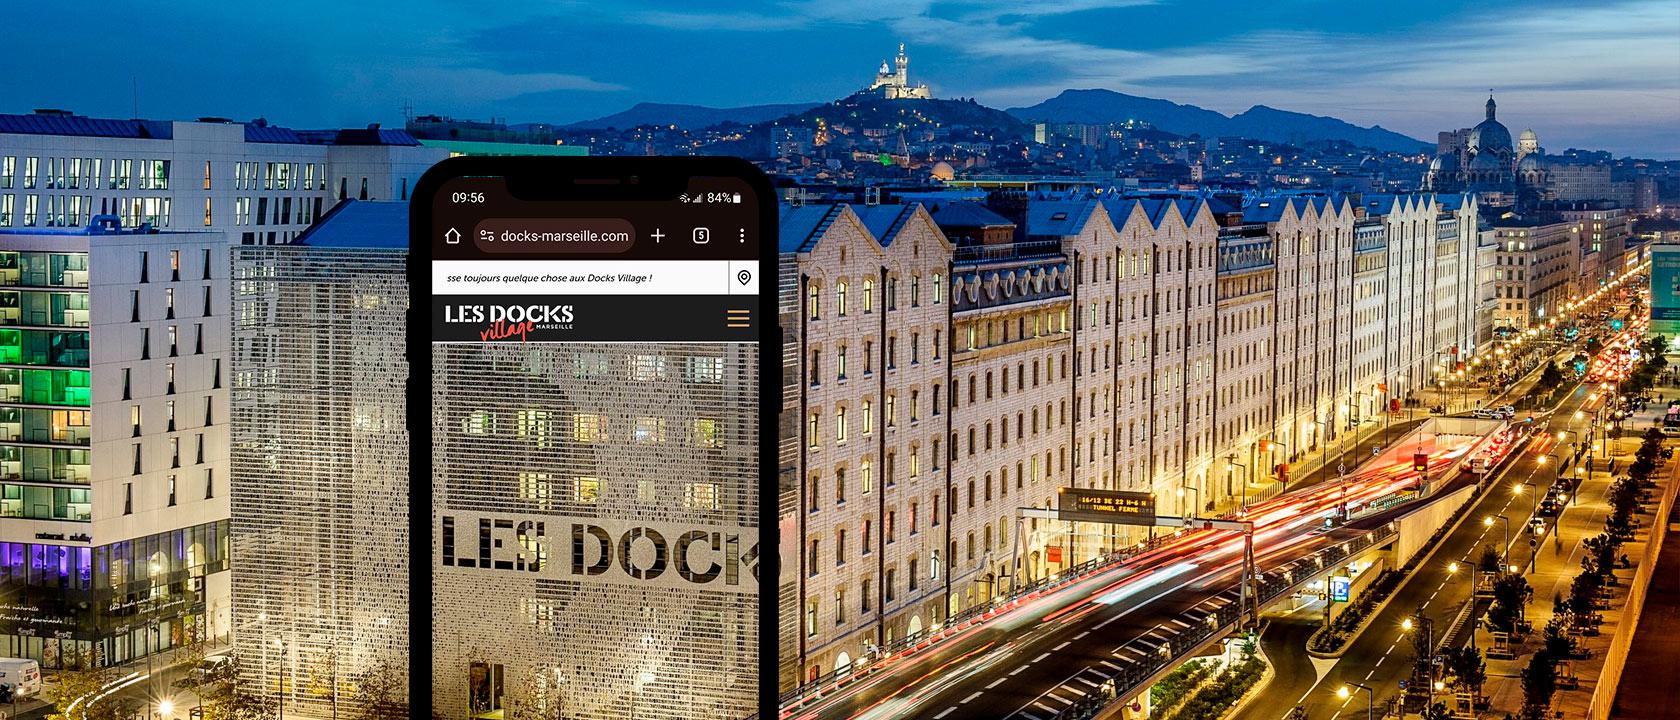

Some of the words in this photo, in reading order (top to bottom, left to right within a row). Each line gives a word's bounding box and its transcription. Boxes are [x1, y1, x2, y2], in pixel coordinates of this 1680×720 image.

[452, 192, 485, 204] 09:56
[707, 192, 732, 204] 84%
[500, 229, 629, 242] docks-marseille.com
[698, 231, 704, 240] 5
[464, 274, 500, 284] toujours
[502, 274, 538, 284] quelque
[541, 273, 567, 282] chose
[588, 273, 615, 282] Docks
[617, 273, 646, 284] Village
[445, 305, 484, 322] LES
[490, 305, 573, 322] DOCKS
[480, 319, 534, 343] village
[442, 516, 545, 573] LES
